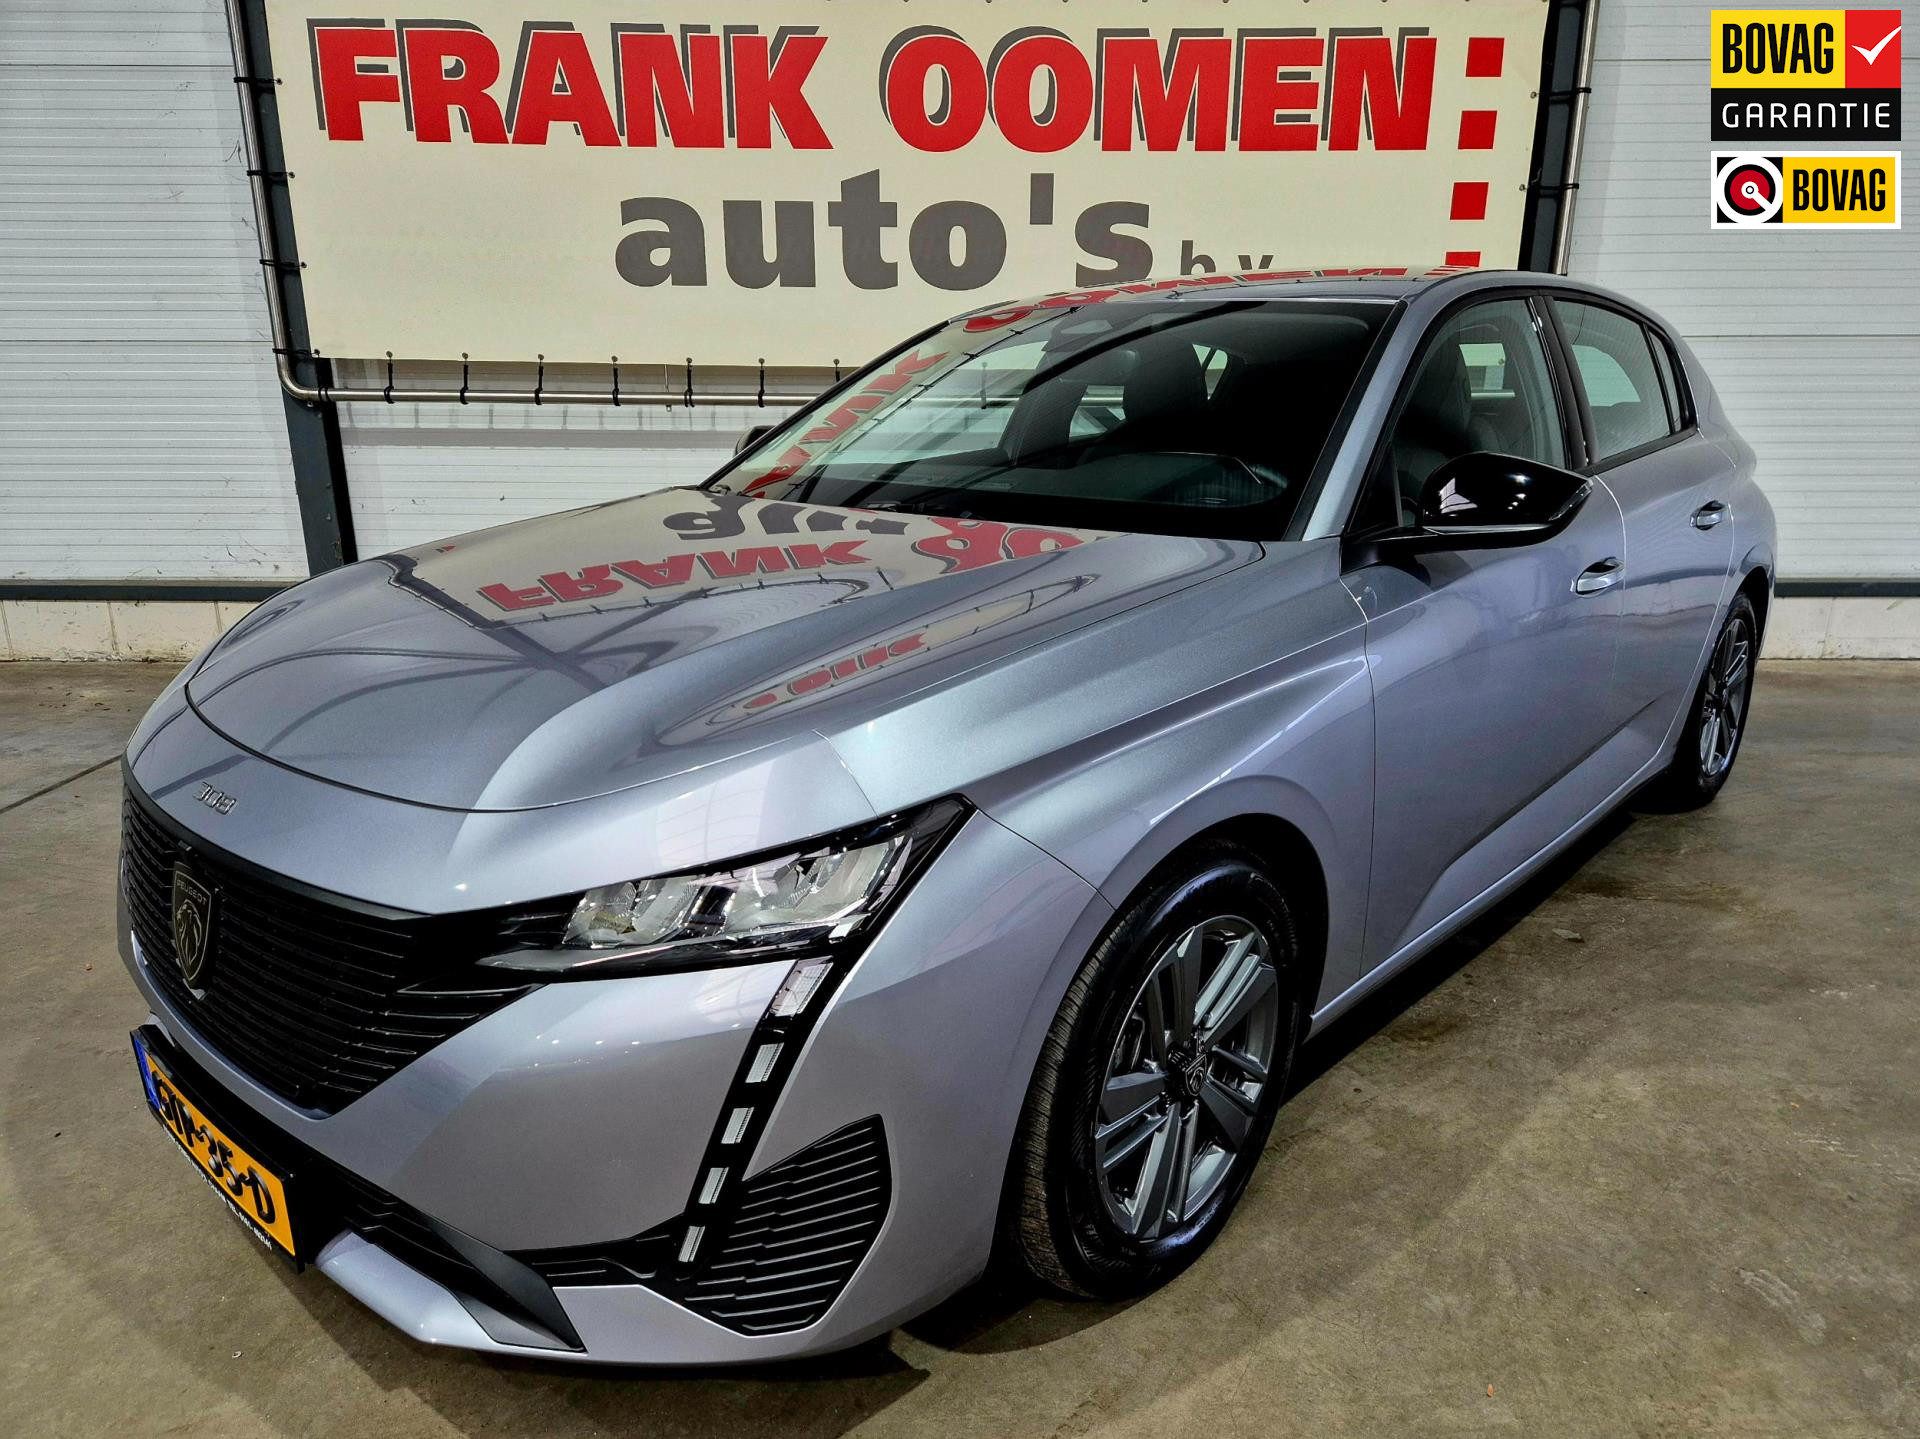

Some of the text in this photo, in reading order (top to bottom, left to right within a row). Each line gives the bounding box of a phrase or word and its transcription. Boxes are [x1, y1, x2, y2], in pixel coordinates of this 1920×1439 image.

[307, 18, 1437, 152] FRANK OOMEN
[614, 168, 1154, 291] auto's
[176, 879, 208, 905] PEUGEOT
